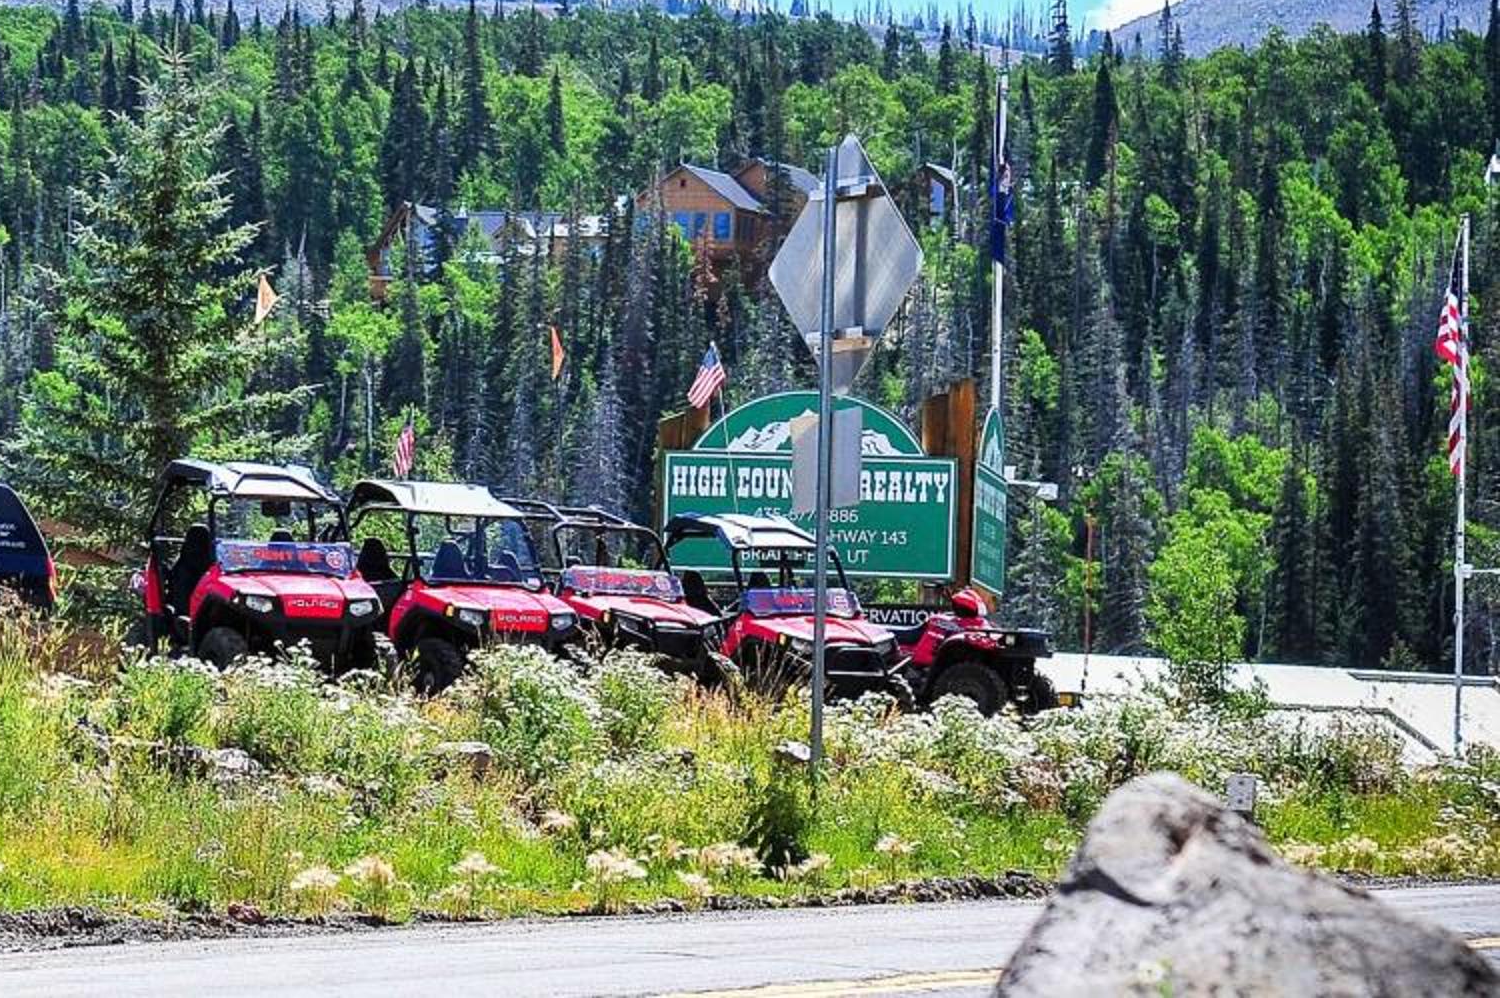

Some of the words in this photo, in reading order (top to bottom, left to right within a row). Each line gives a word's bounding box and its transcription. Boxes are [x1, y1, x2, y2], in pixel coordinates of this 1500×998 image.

[671, 465, 728, 497] HIGH
[737, 466, 793, 499] COUN
[859, 469, 949, 503] REALTY
[881, 531, 908, 546] 143
[847, 549, 869, 564] UT
